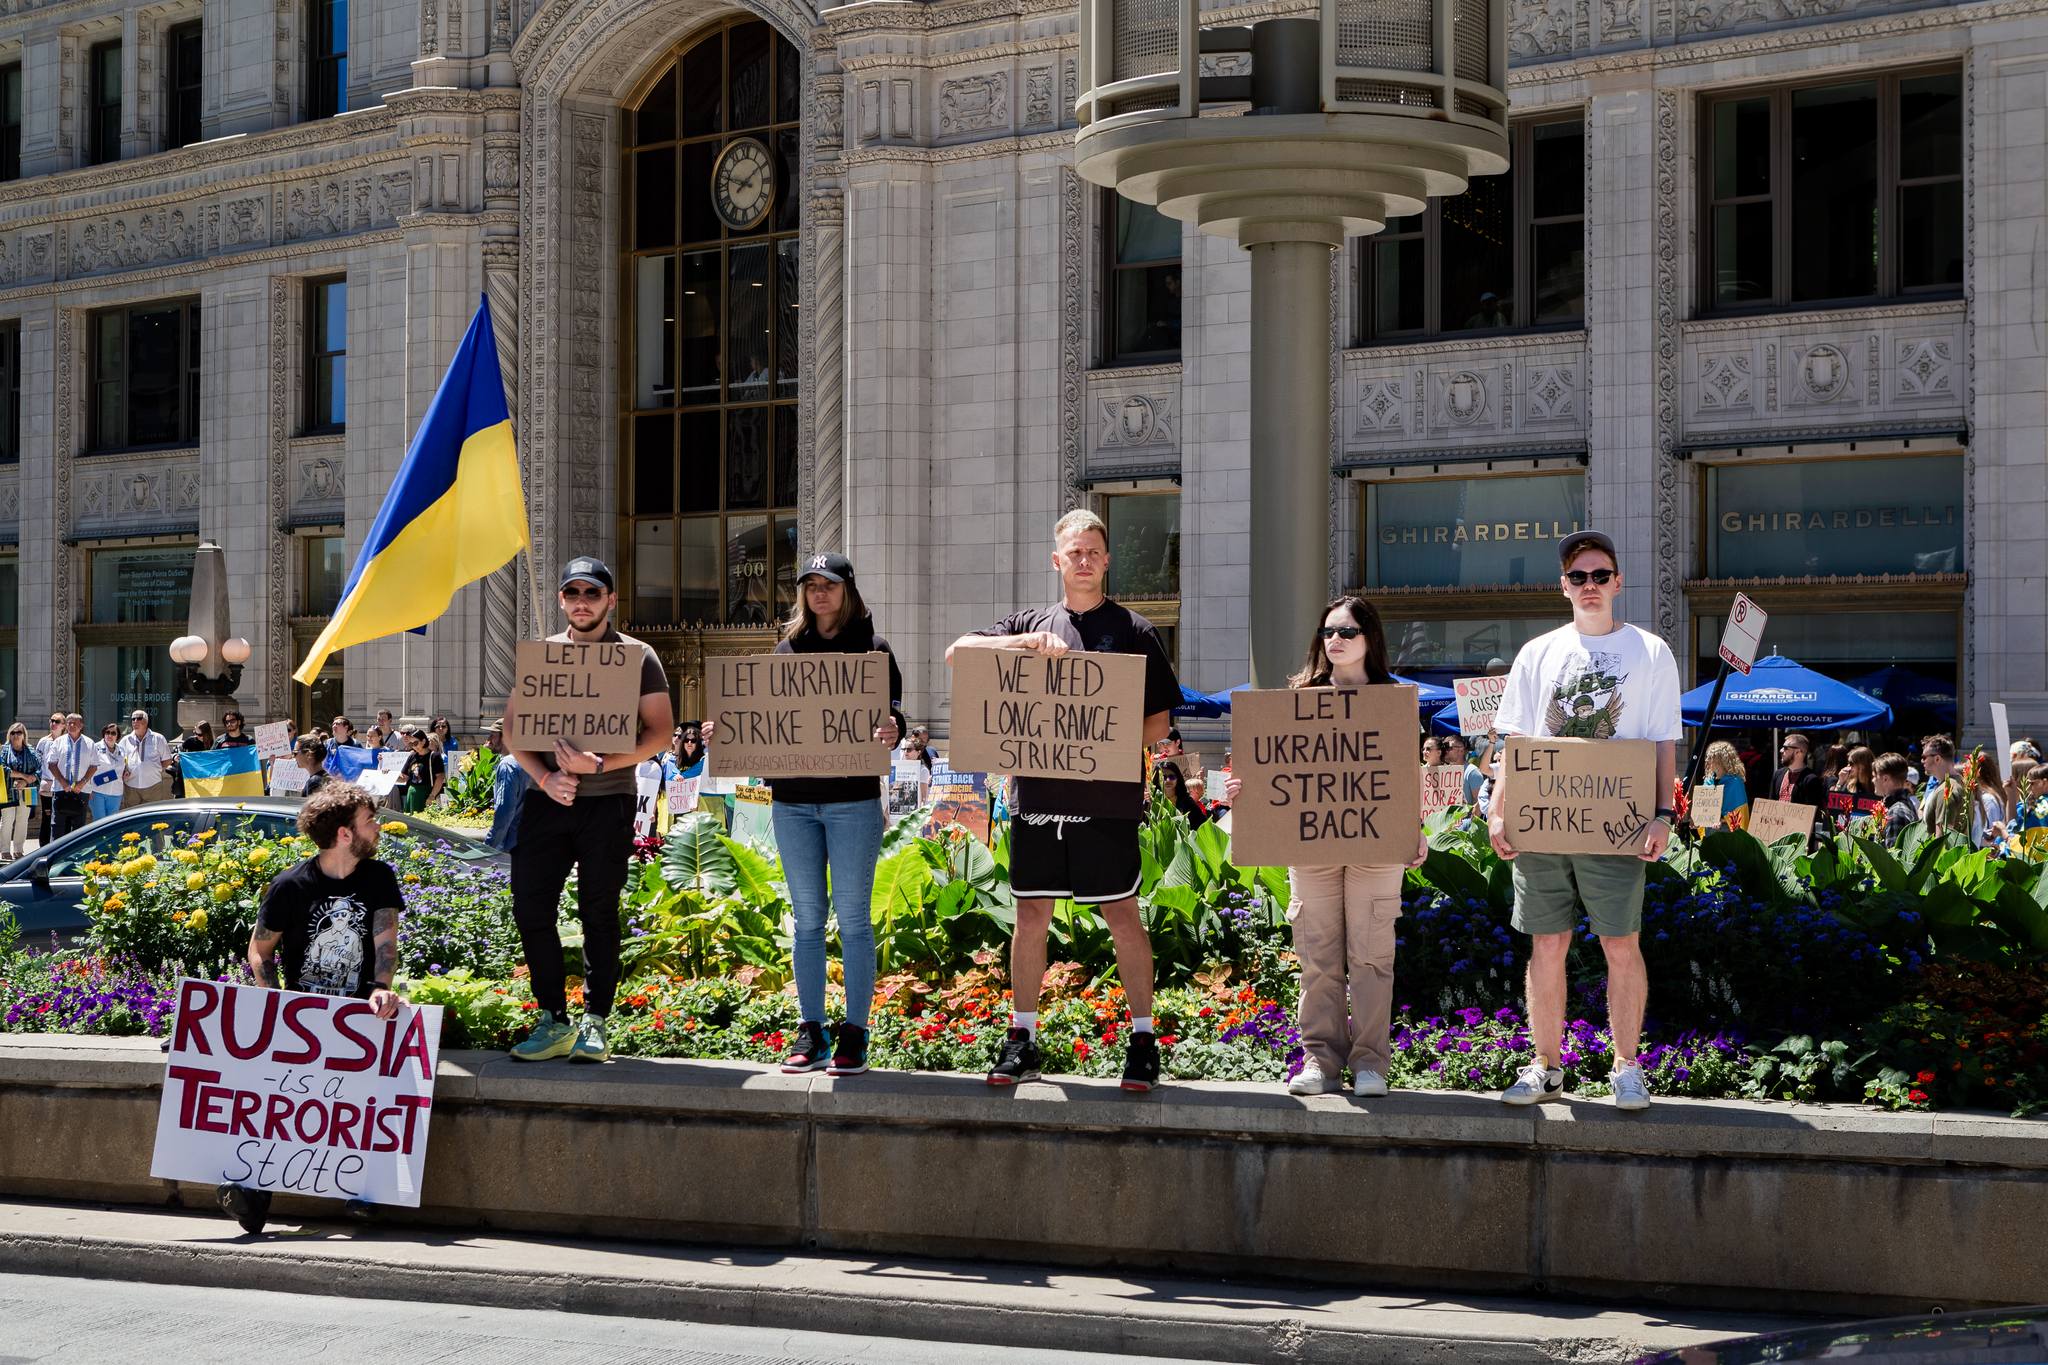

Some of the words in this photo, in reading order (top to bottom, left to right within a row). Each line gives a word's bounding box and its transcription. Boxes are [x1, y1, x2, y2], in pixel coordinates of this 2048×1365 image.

[1721, 505, 1954, 533] GHIRARDELLI
[1380, 521, 1579, 545] GHIRARDELLI
[733, 562, 764, 577] 400
[545, 643, 590, 666] LET
[599, 643, 626, 667] US
[522, 673, 600, 698] SHELL
[721, 662, 761, 697] LET
[770, 659, 878, 697] UKRAINE
[995, 654, 1035, 694] WE
[1045, 657, 1104, 697] NEED
[1470, 678, 1508, 697] STOP
[110, 693, 142, 702] DUSABLE
[144, 693, 172, 702] BRIDGE
[1294, 690, 1358, 721] LET
[517, 713, 577, 736] THEM
[583, 713, 630, 736] BACK
[720, 710, 803, 745] STRIKE
[822, 708, 882, 744] BACK
[983, 699, 1119, 742] LONG-RANGE
[1463, 712, 1498, 733] AGGRE
[998, 739, 1097, 775] STRIKES
[1514, 748, 1560, 772] LET
[932, 764, 943, 775] LET
[932, 774, 952, 785] STRIKE
[952, 774, 974, 784] BACK
[943, 785, 973, 793] GENOCIDE
[943, 793, 980, 802] HOMETOWN
[1269, 770, 1391, 806] STRIKE
[1538, 774, 1633, 800] UKRAINE
[1300, 806, 1380, 841] BACK
[1518, 804, 1595, 834] STRKE
[322, 1076, 345, 1099] a
